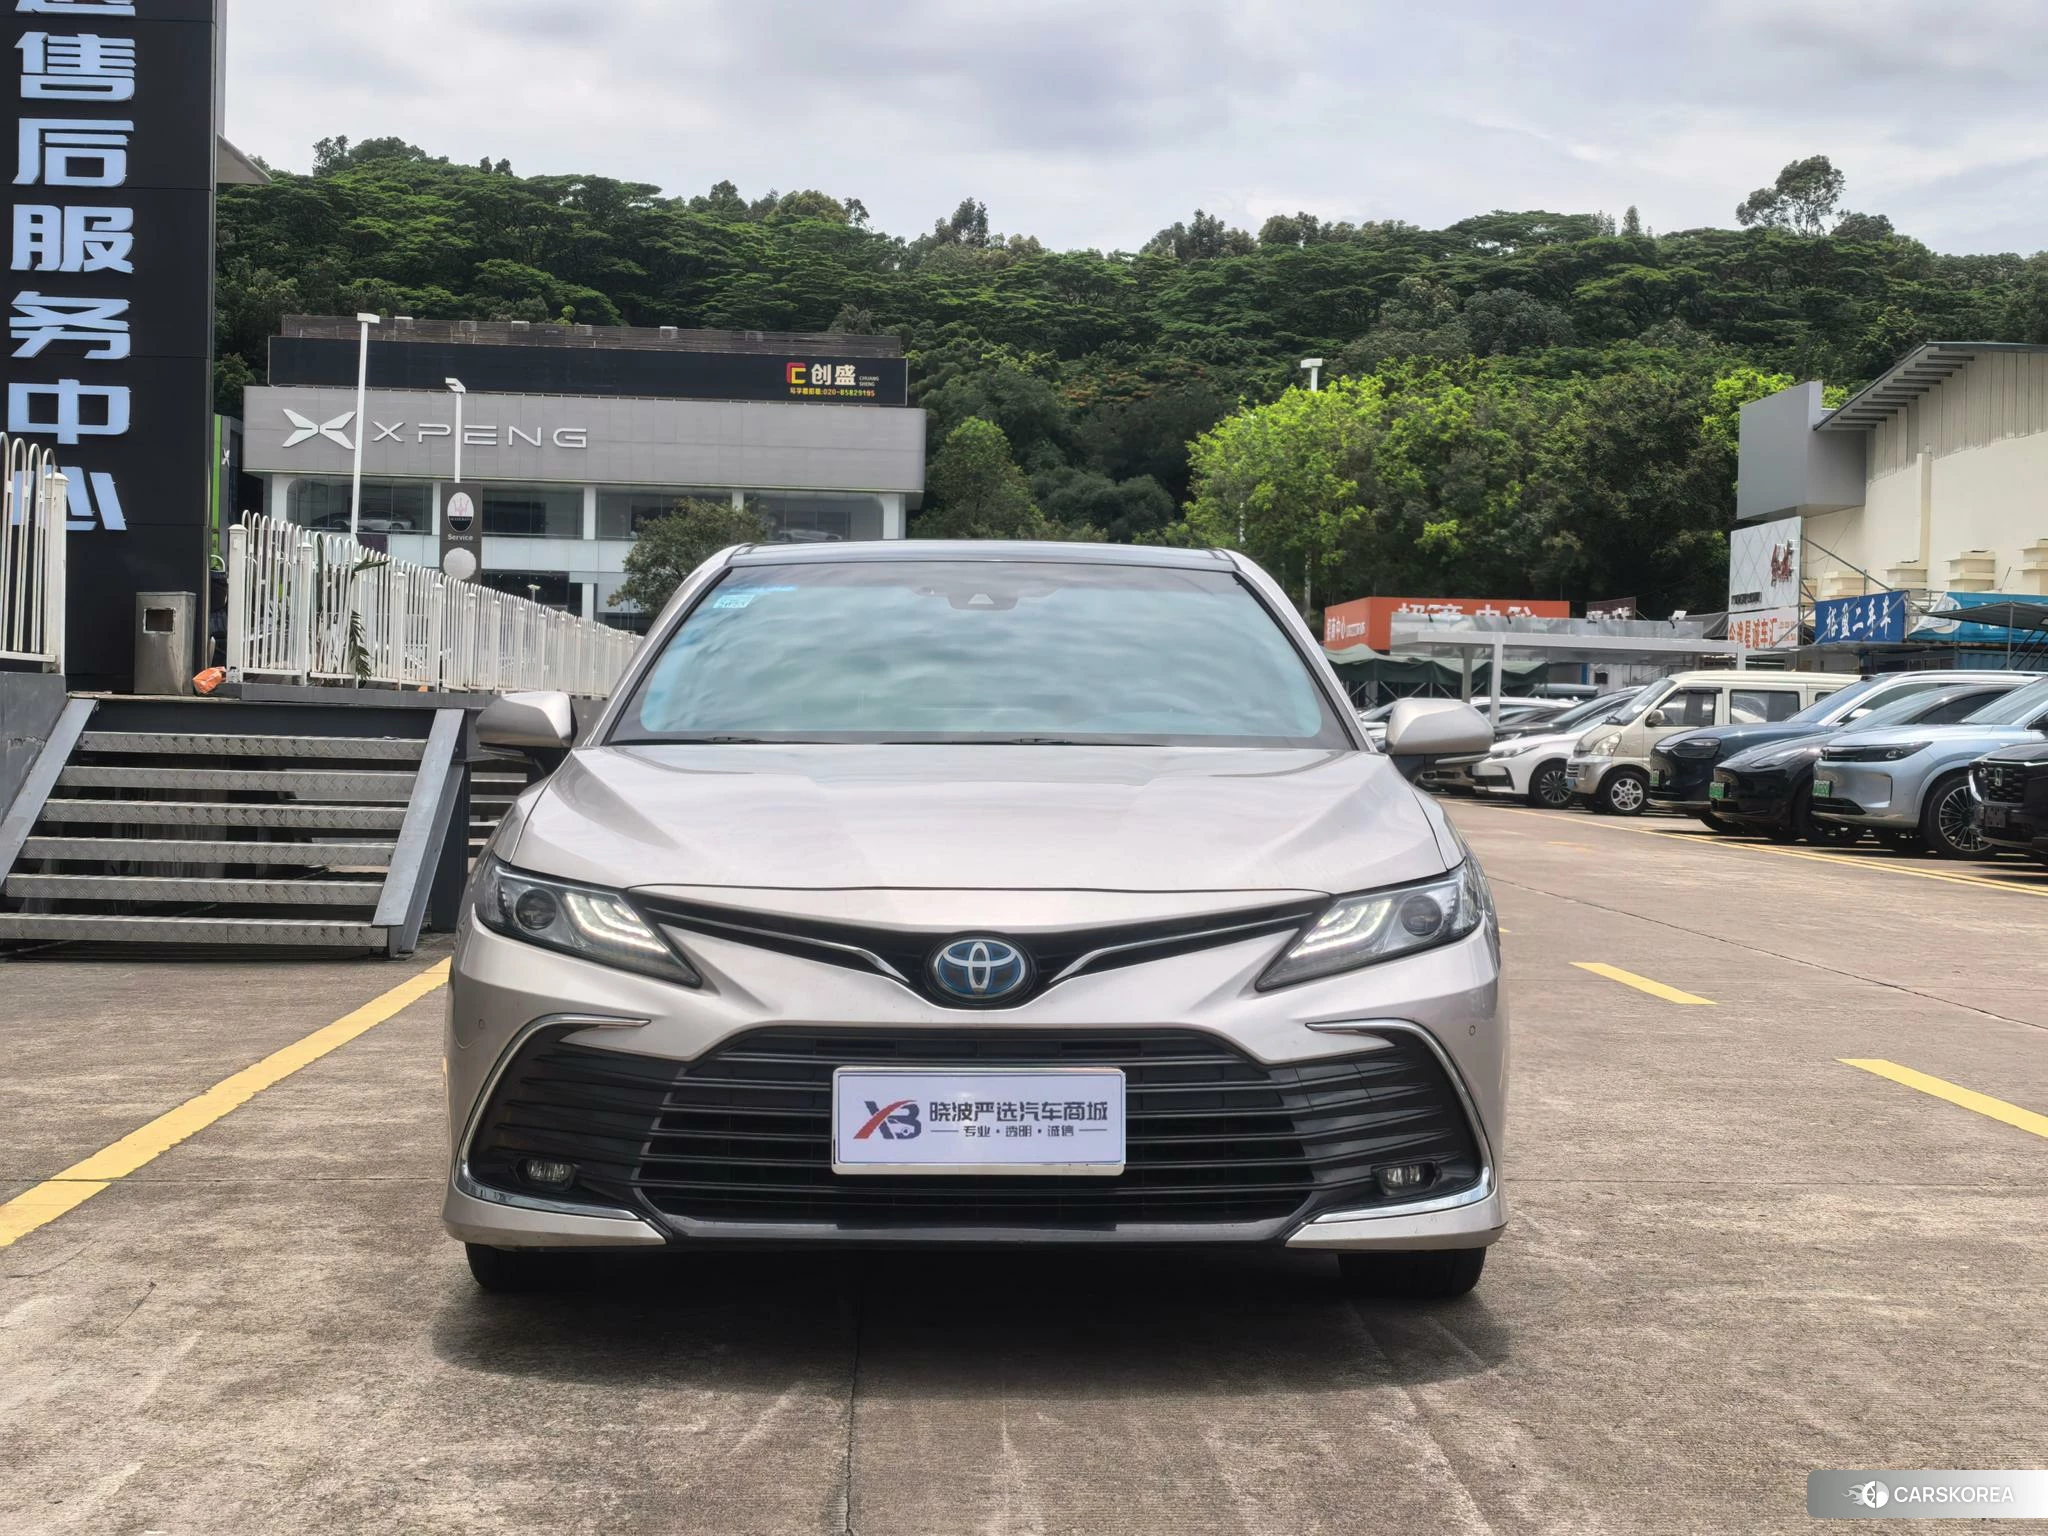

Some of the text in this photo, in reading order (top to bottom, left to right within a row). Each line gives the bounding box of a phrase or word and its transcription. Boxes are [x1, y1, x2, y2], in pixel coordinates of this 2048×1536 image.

[8, 0, 136, 531] 售后服务中心
[811, 364, 856, 385] 创盛
[372, 421, 588, 448] XPENG
[448, 533, 473, 541] Service
[929, 1101, 1108, 1122] 晓波严选汽车商城
